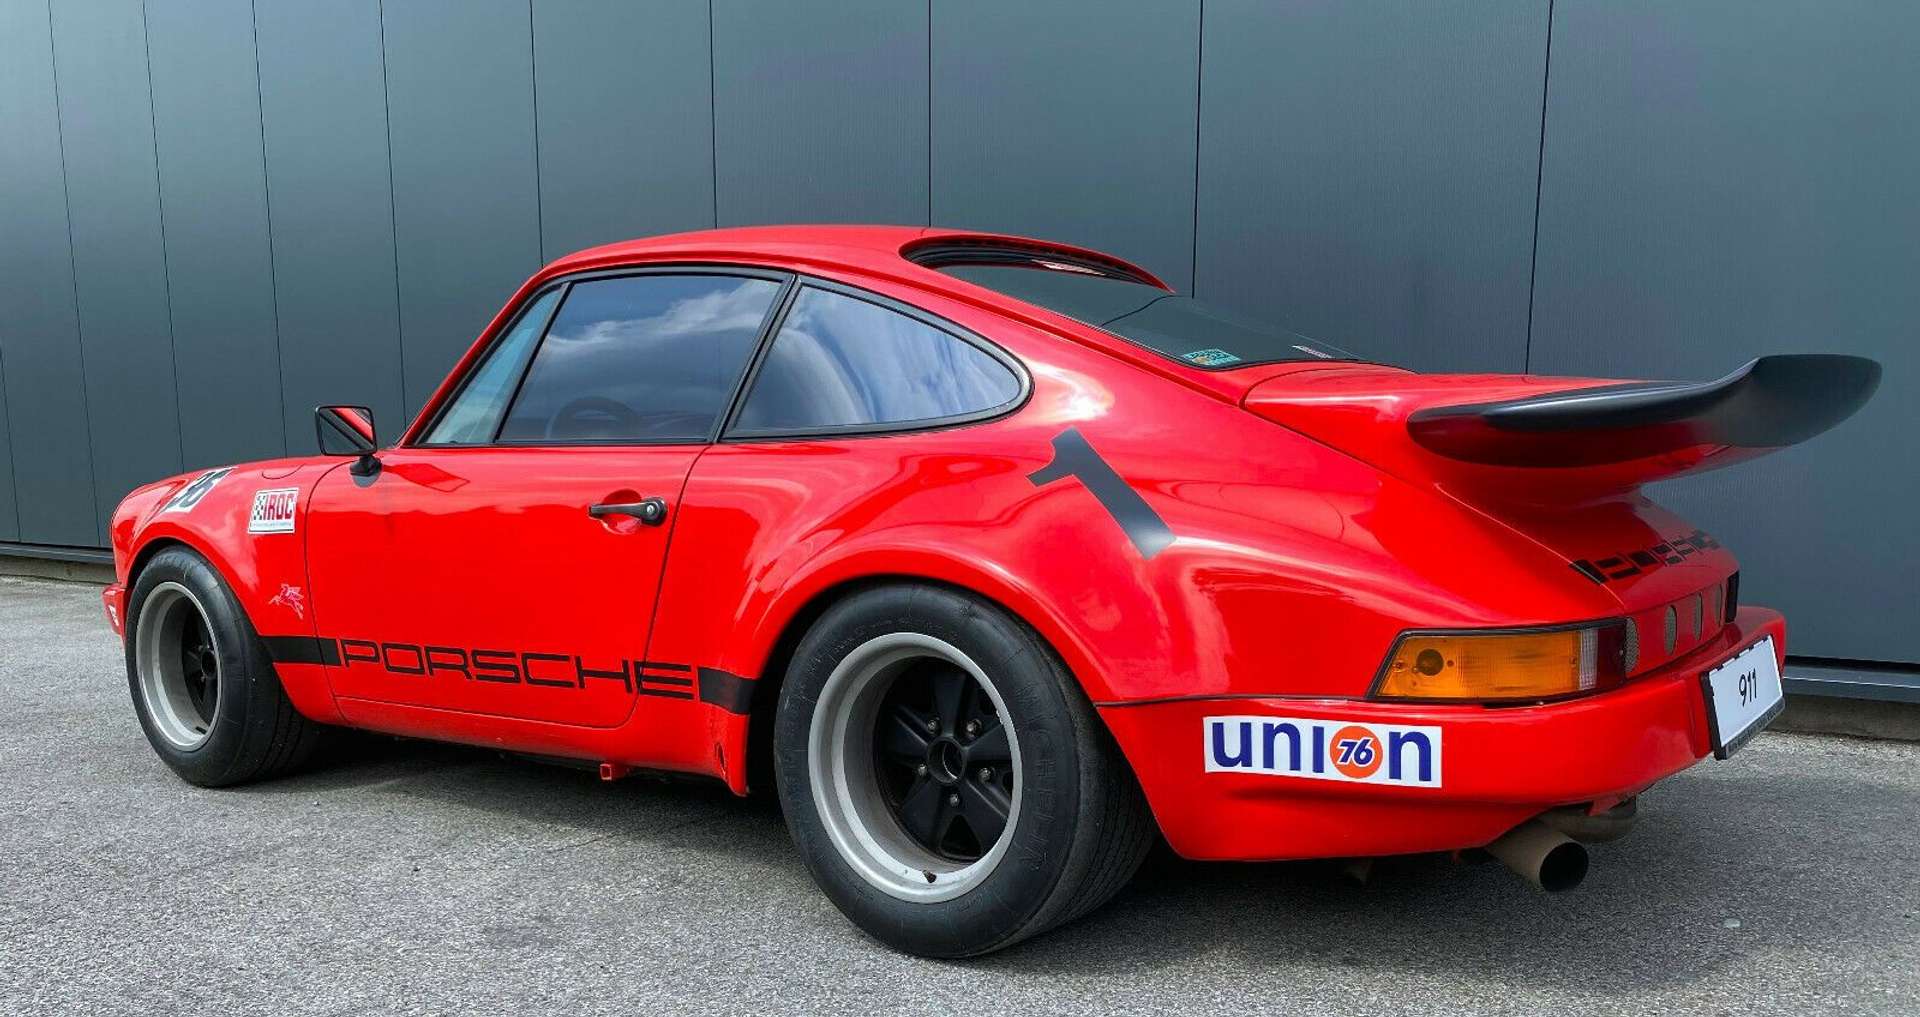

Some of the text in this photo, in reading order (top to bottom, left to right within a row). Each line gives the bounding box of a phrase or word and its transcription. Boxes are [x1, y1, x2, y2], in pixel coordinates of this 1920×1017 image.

[262, 493, 295, 520] IROC
[341, 638, 696, 700] PORSCHE
[1738, 667, 1757, 707] 911
[1336, 738, 1375, 766] 76
